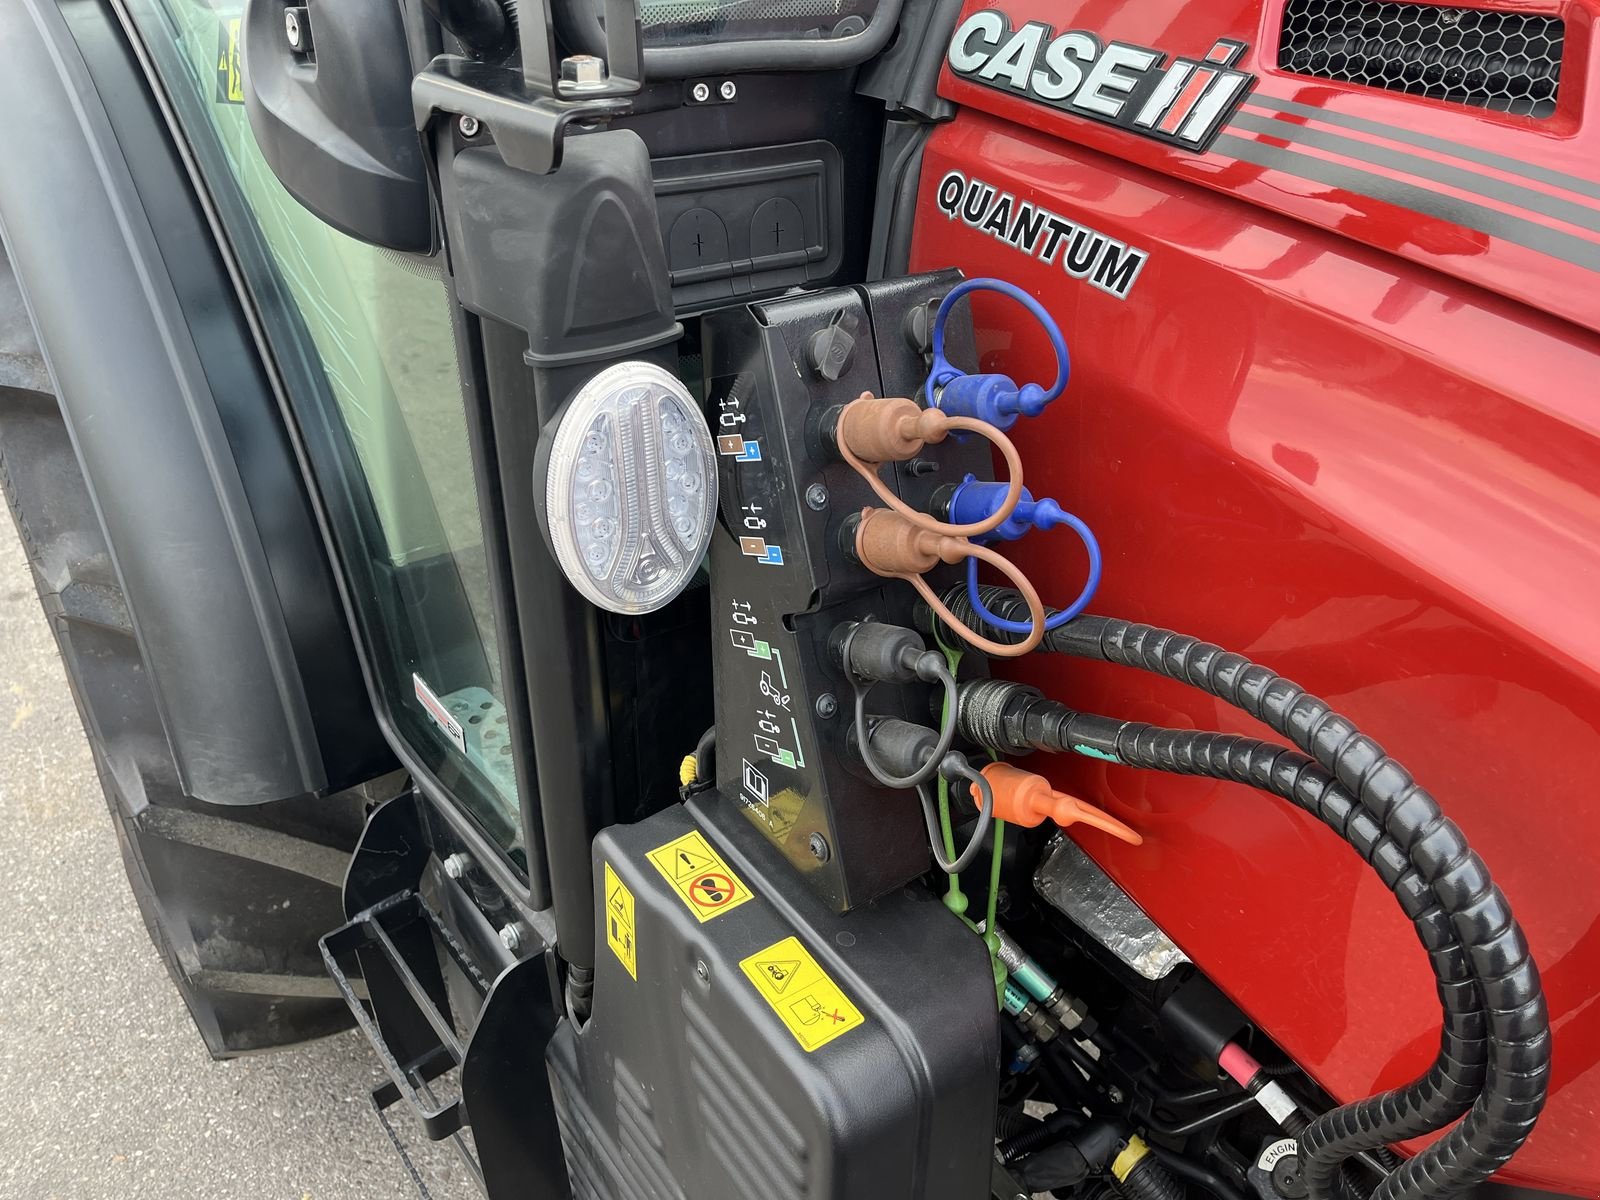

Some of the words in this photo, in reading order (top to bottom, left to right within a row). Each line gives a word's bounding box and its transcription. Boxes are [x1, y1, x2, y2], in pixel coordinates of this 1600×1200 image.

[949, 10, 1157, 118] CASE
[938, 173, 1147, 297] QUANTUM
[1265, 1143, 1296, 1165] ENGIN
